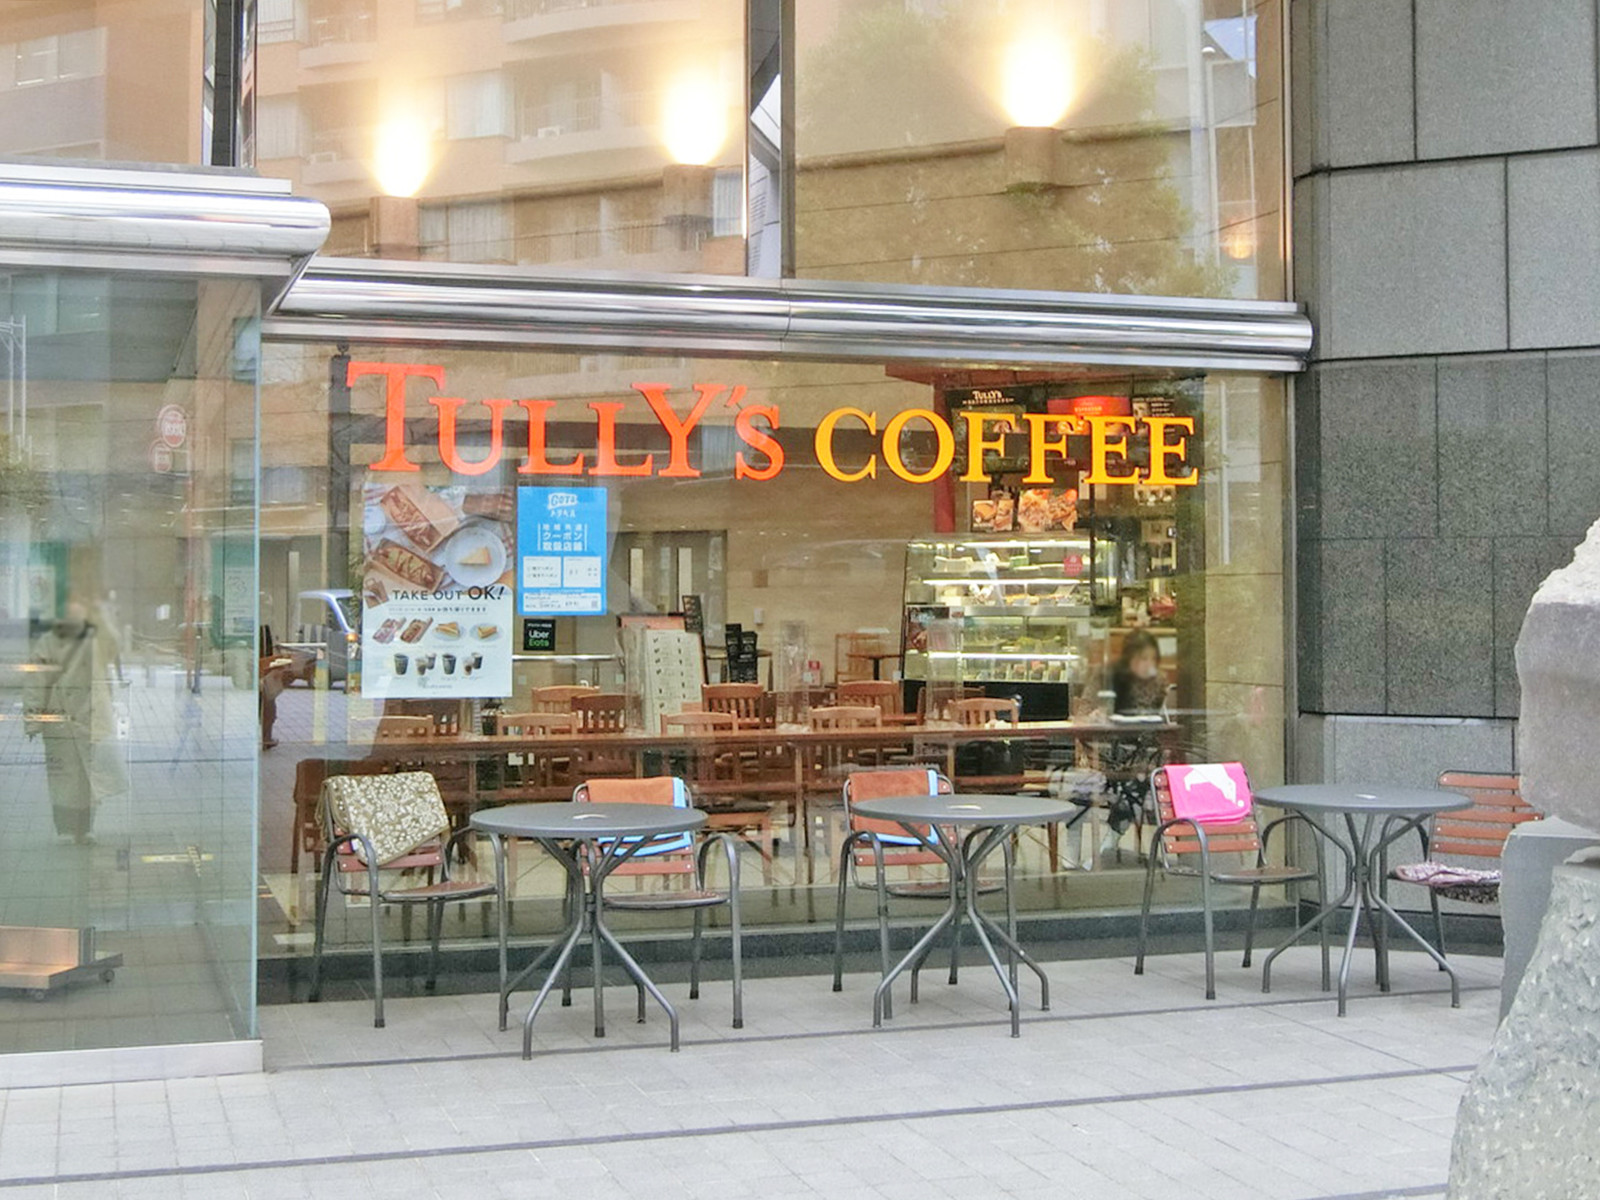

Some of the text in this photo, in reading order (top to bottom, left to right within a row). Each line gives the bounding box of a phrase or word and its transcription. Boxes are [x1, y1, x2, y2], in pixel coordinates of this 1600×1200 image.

[346, 361, 1199, 486] TULLY'S COFFEE
[542, 532, 583, 541] クーポン
[392, 585, 505, 601] TAKE OUT OK!
[528, 629, 550, 639] Uber
[528, 638, 550, 647] Eats
